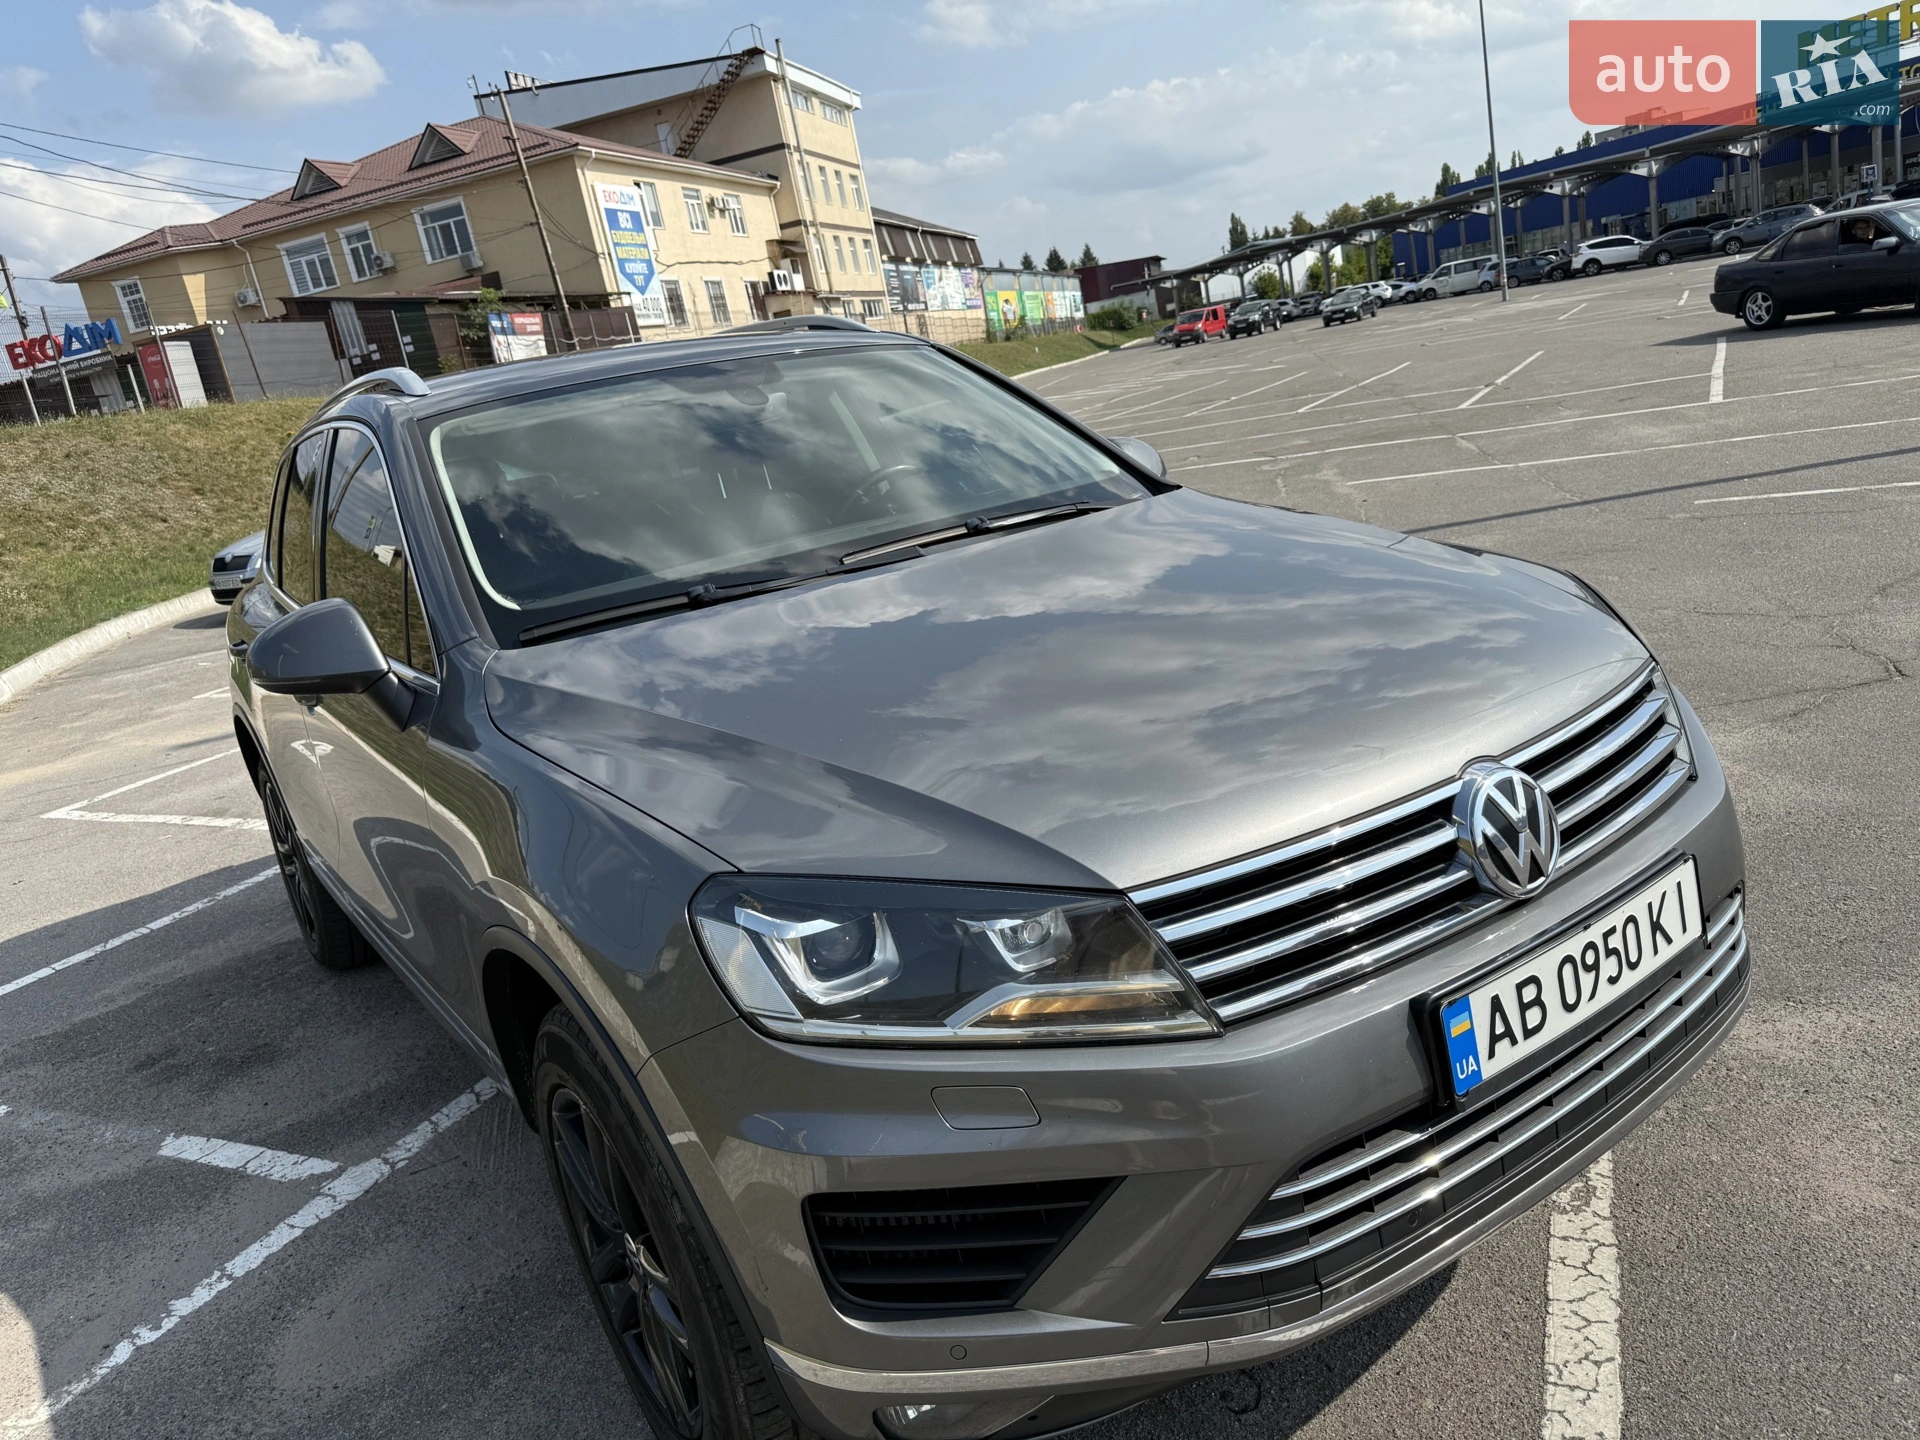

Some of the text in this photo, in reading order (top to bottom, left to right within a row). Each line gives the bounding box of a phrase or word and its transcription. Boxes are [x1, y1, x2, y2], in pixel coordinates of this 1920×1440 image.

[603, 189, 636, 206] ЕКОДІМ
[5, 318, 123, 370] ЕКОДІМ
[1487, 880, 1688, 1061] AB 0950 KI
[1456, 1055, 1479, 1079] UA
